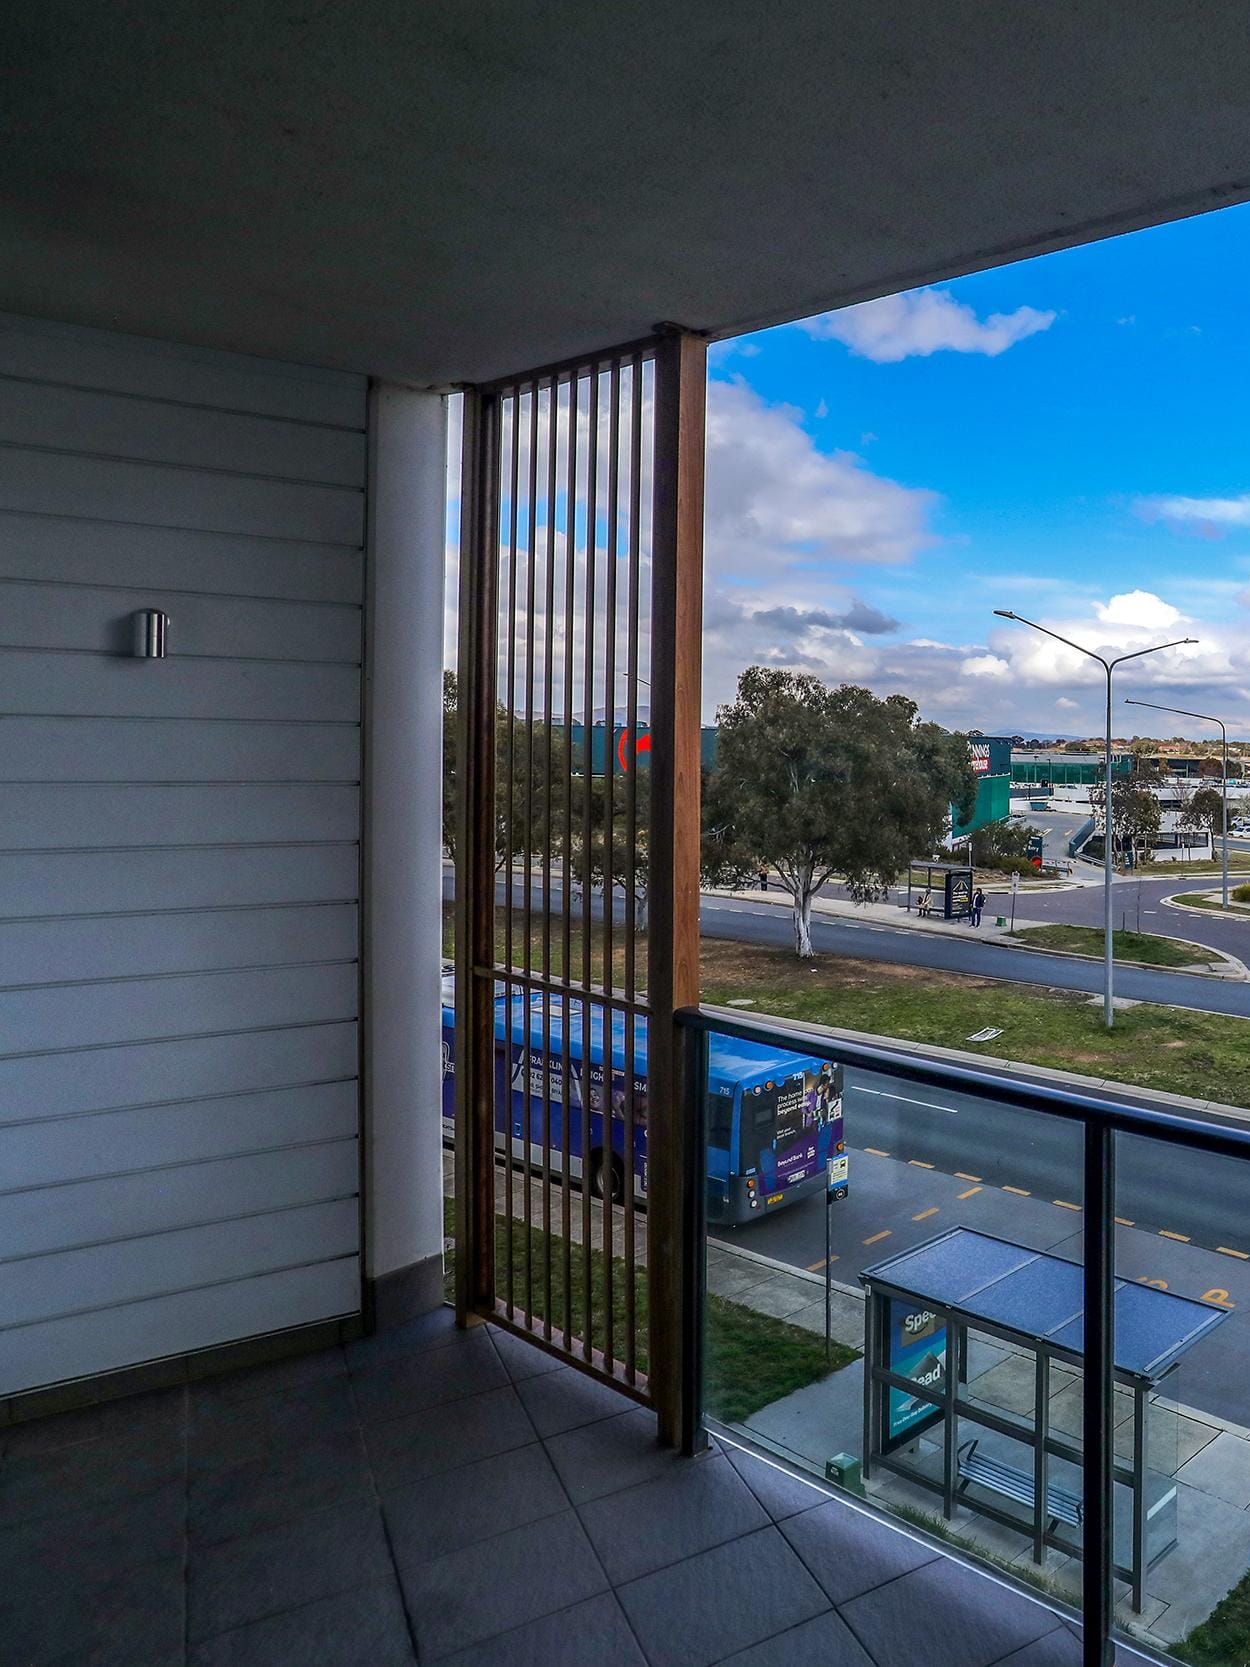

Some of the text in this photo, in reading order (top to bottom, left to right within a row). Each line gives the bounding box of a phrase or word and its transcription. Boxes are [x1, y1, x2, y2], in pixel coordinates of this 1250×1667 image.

[720, 1086, 730, 1096] 715
[777, 1095, 788, 1103] The
[788, 1090, 802, 1100] home
[777, 1098, 798, 1110] process
[777, 1104, 798, 1116] beyond
[911, 1363, 941, 1386] ead
